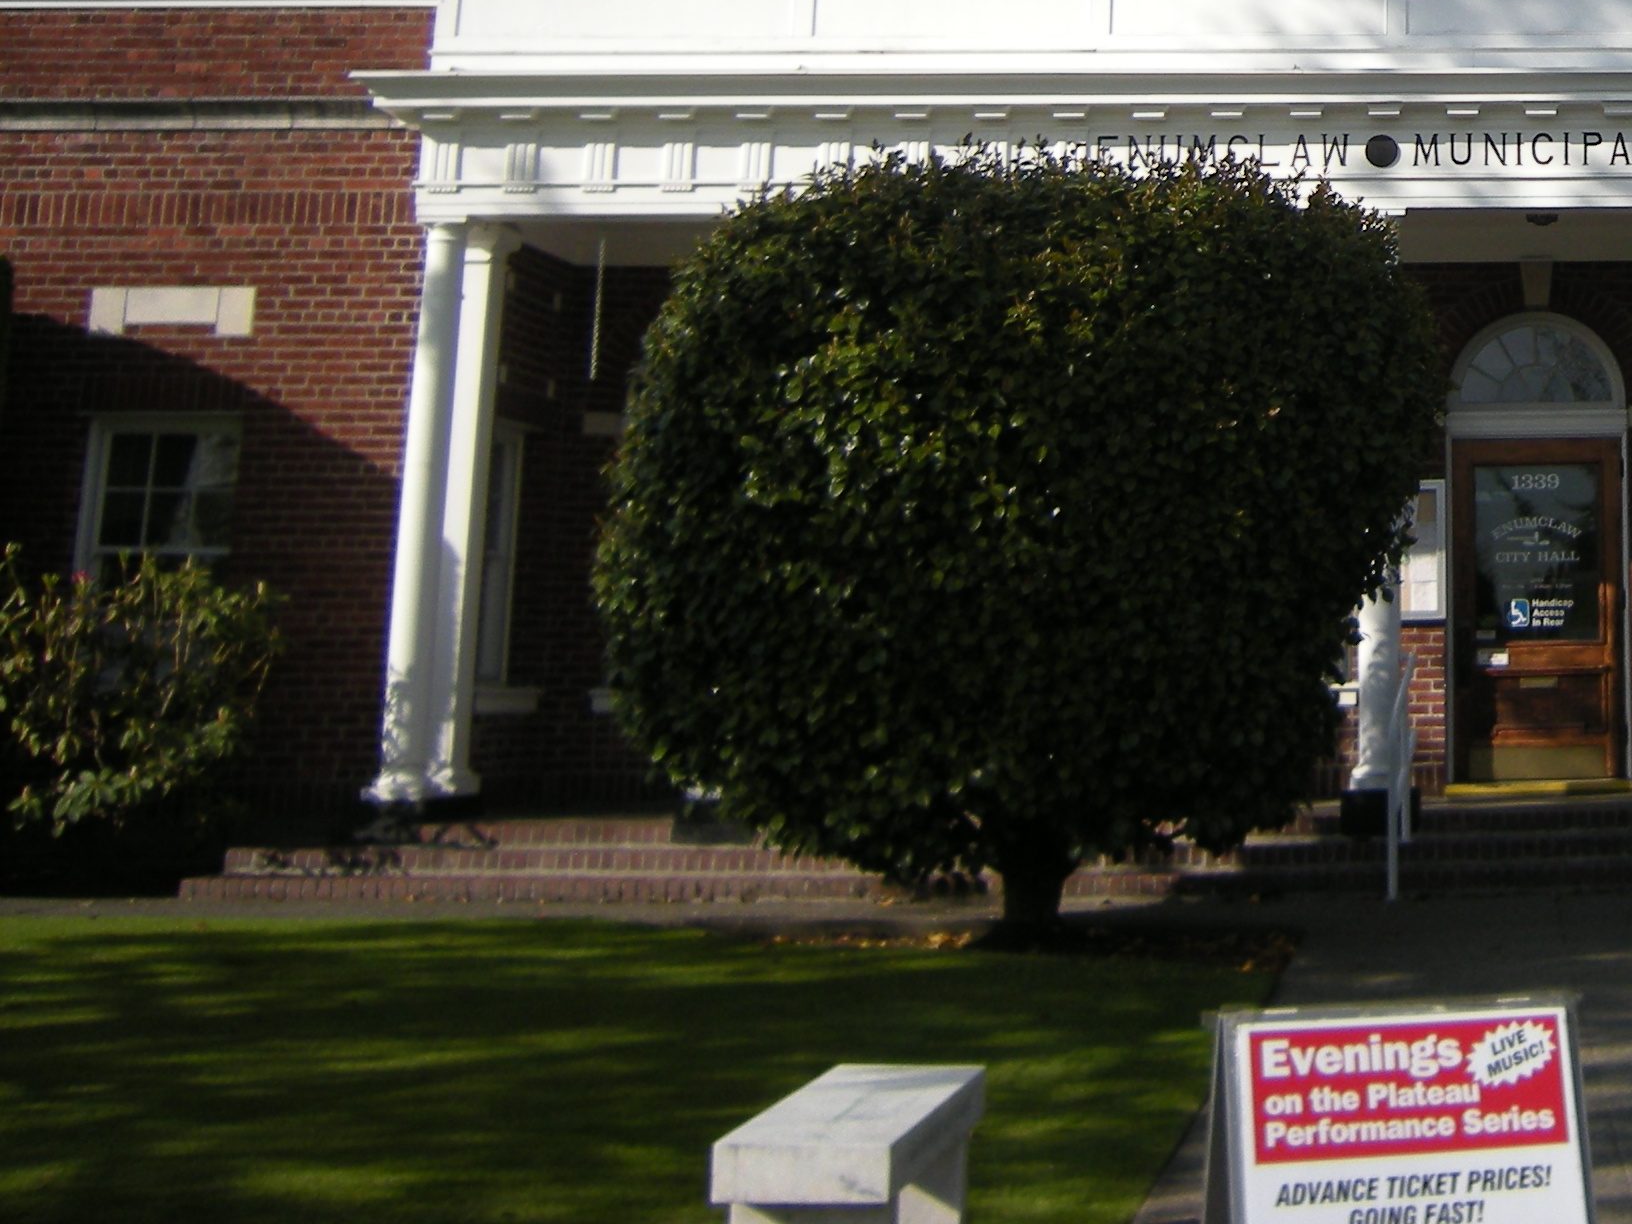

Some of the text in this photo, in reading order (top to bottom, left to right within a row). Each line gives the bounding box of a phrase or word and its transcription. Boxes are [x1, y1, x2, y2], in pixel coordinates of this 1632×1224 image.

[1492, 516, 1583, 539] ENUMCLAW
[1495, 551, 1580, 563] CITY HALL
[1531, 598, 1574, 608] Handicap
[1532, 608, 1565, 617] Access
[1543, 617, 1565, 627] Rear
[1491, 1029, 1527, 1056] LIVE
[1261, 1033, 1463, 1079] Evenings
[1487, 1040, 1545, 1078] MUSIC!
[1264, 1080, 1481, 1116] on the Plateau
[1265, 1105, 1556, 1149] Performance Series
[1275, 1165, 1553, 1207] ADVANCE TICKET PRICES!
[1349, 1199, 1485, 1224] GOING FAST!
